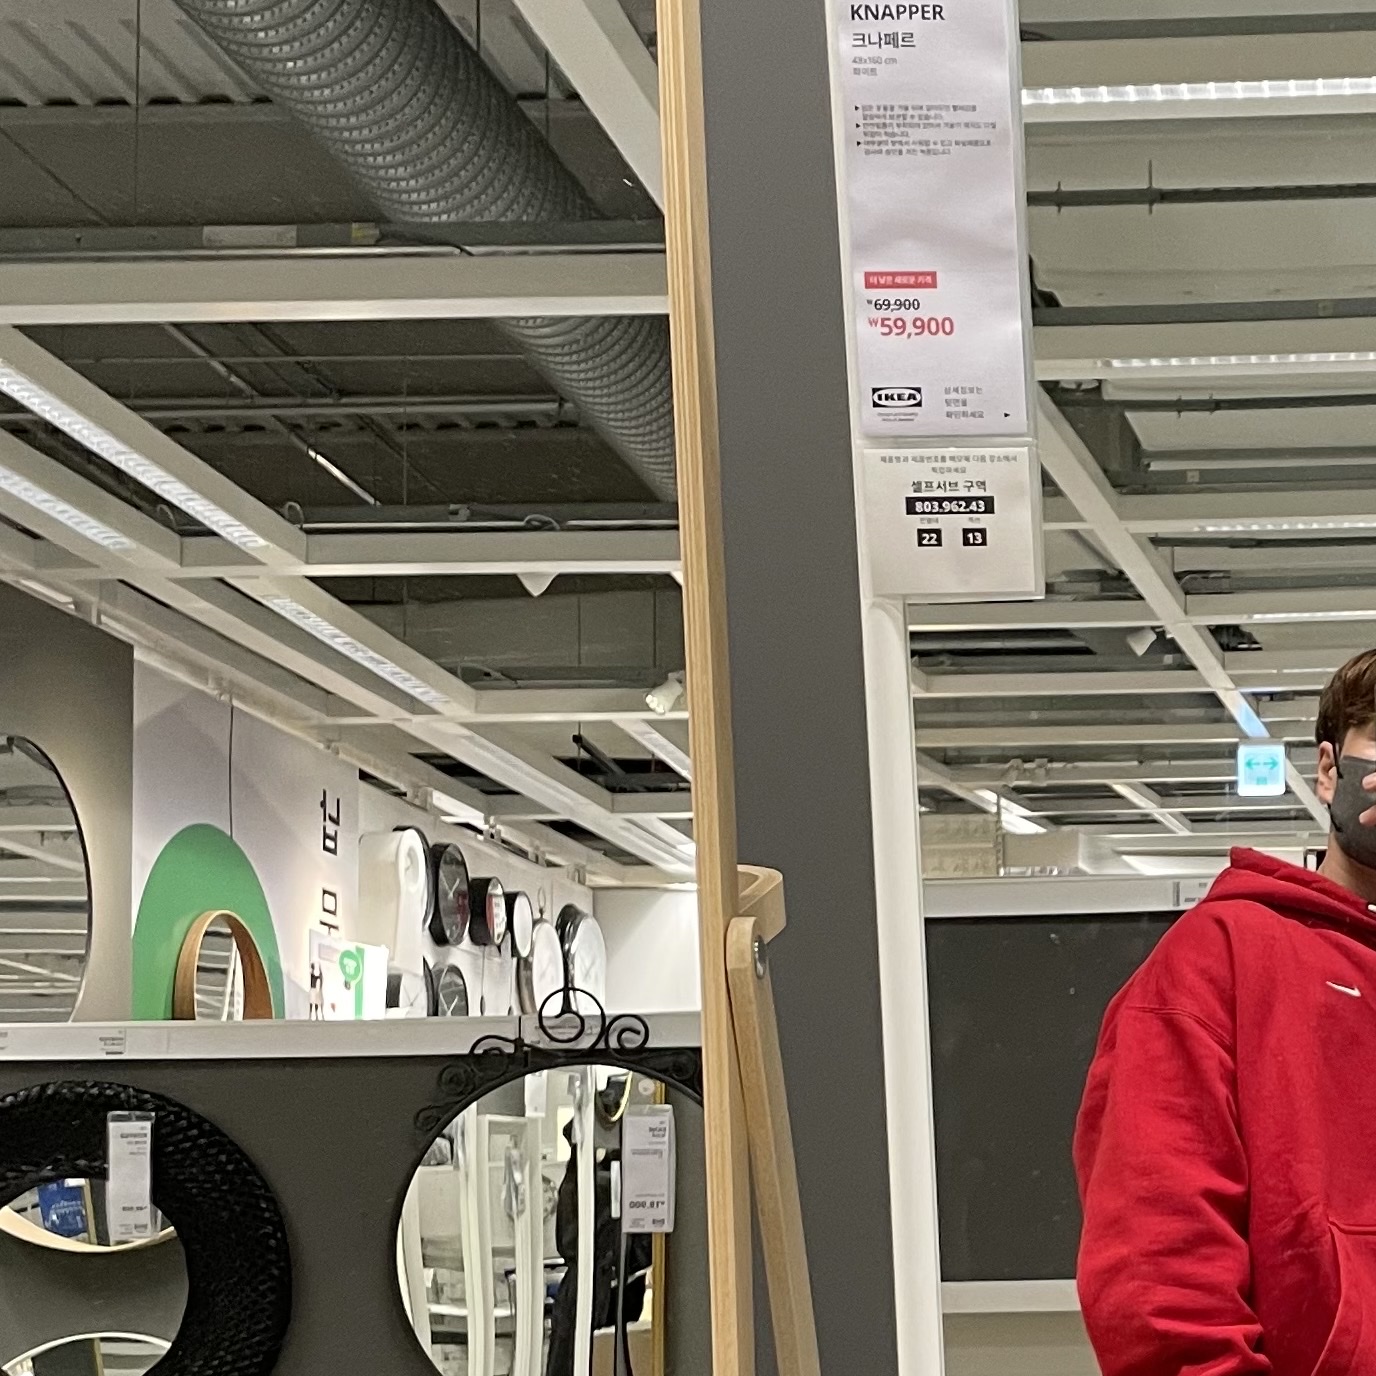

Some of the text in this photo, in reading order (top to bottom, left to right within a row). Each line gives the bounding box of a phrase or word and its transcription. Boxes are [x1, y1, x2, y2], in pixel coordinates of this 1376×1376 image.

[850, 4, 946, 21] KNAPPER
[852, 31, 916, 49] 크나페르
[868, 316, 954, 339] ₩59,900
[877, 393, 918, 401] IKEA
[911, 480, 987, 493] 셀프서브 구역
[914, 501, 986, 513] 803.962.43
[921, 533, 938, 545] 22
[967, 532, 983, 544] 13
